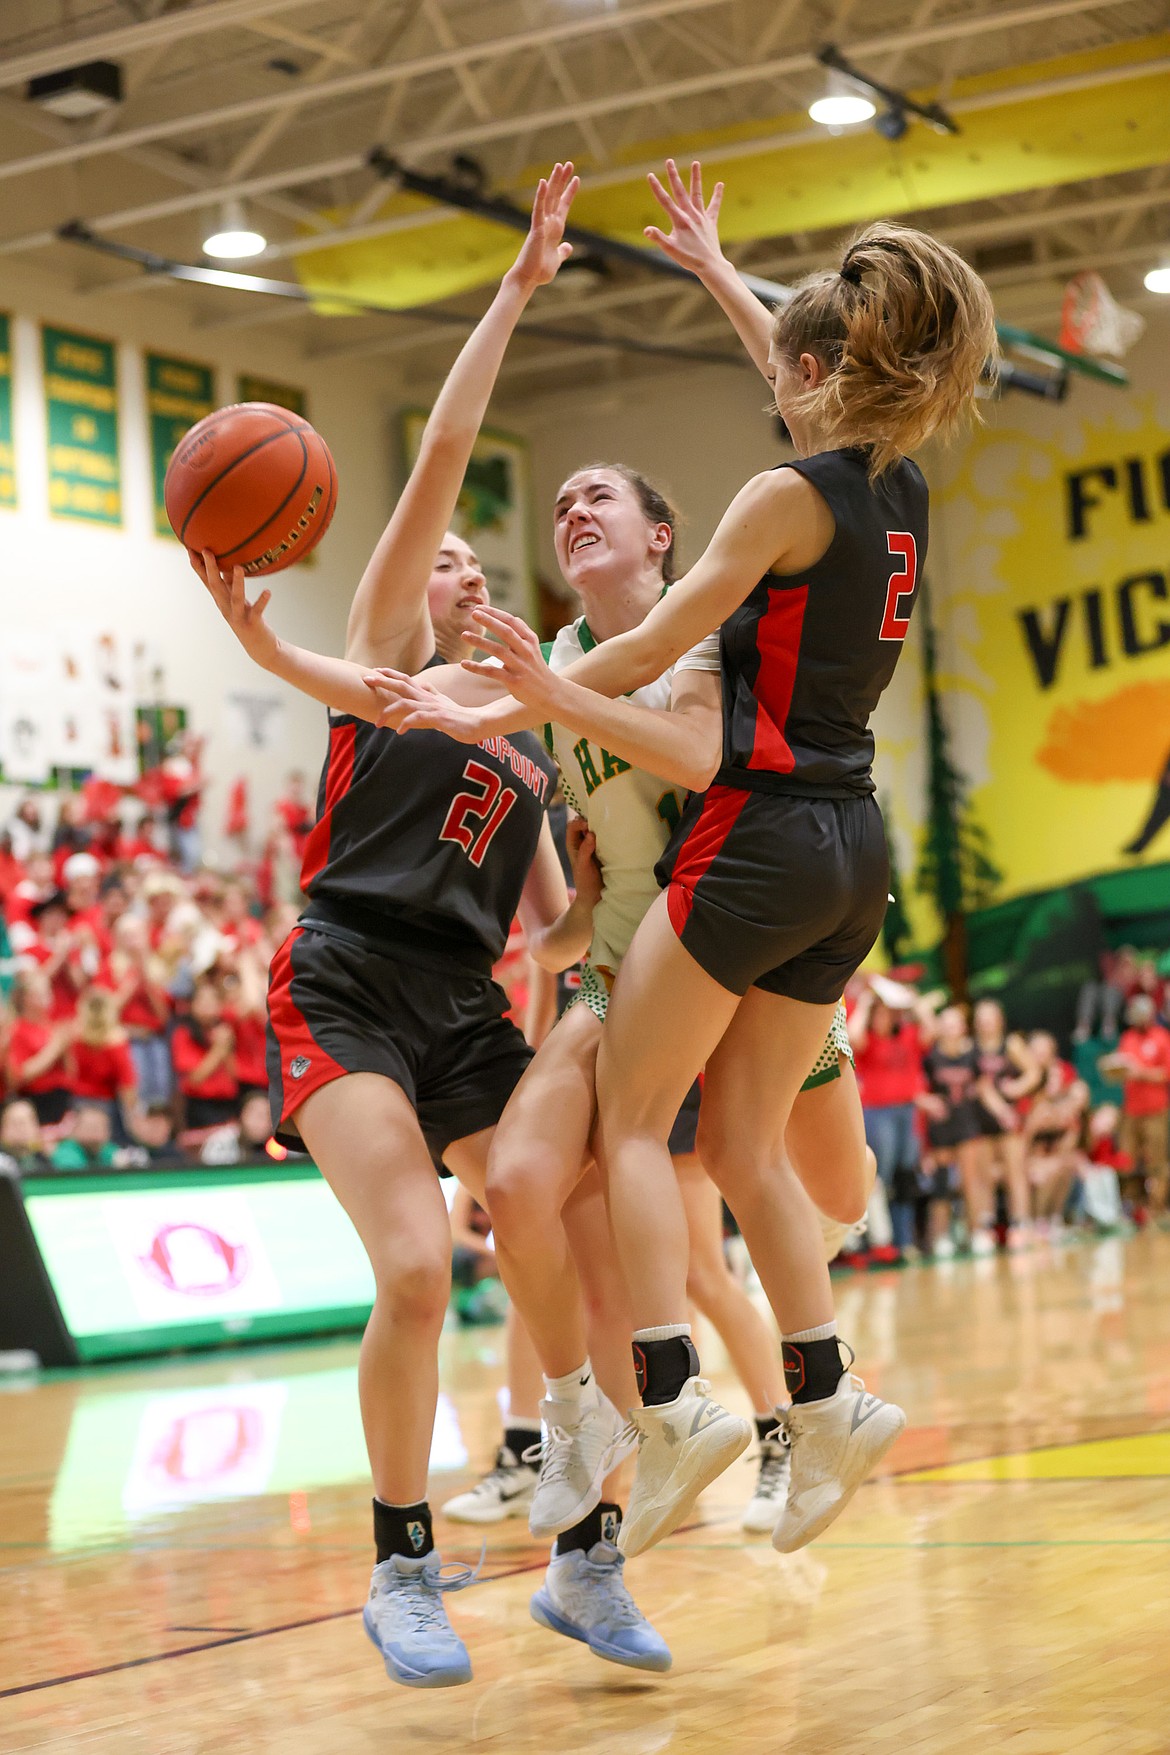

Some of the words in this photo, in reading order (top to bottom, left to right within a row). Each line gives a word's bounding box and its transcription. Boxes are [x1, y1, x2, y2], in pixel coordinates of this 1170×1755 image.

[879, 531, 917, 640] 2
[1018, 571, 1170, 690] VIC
[439, 759, 518, 868] 21
[477, 735, 549, 804] DPOINT
[573, 737, 633, 798] HA
